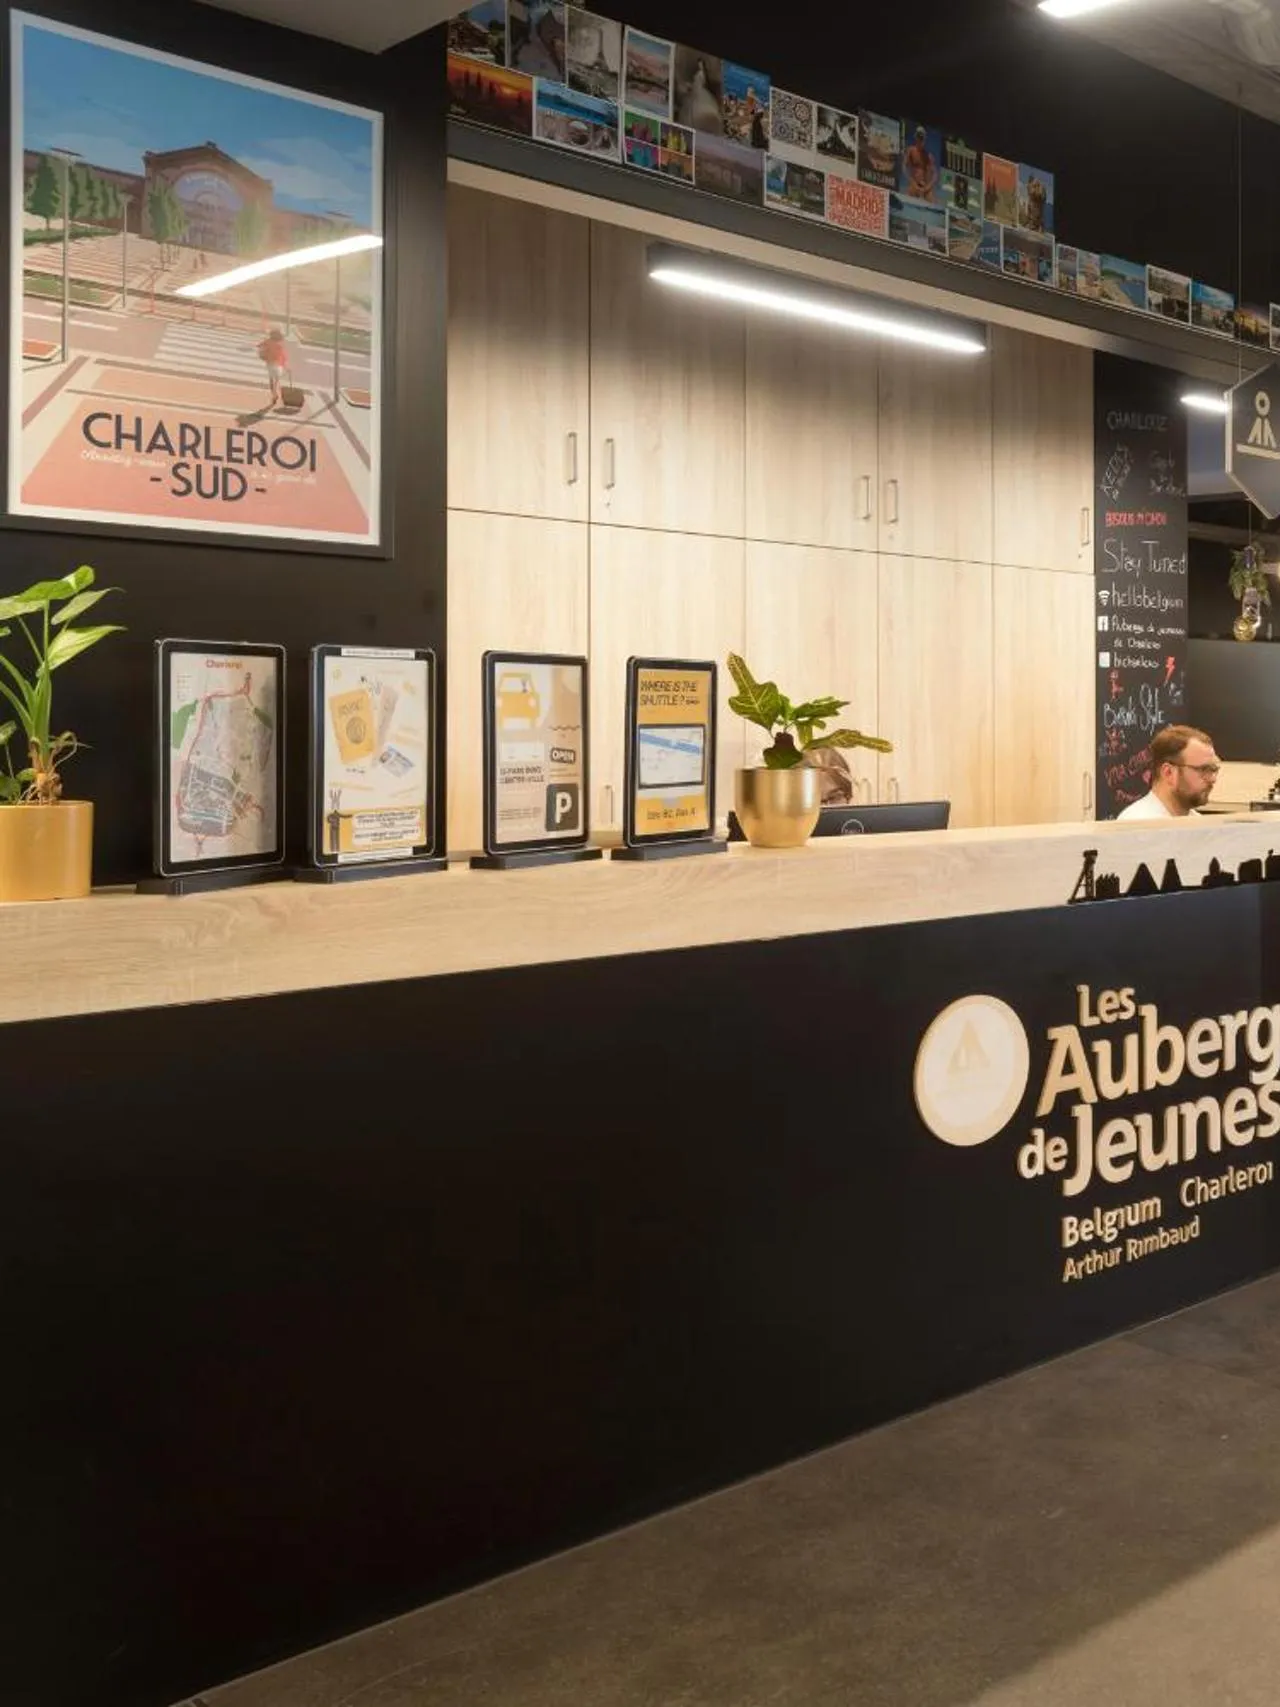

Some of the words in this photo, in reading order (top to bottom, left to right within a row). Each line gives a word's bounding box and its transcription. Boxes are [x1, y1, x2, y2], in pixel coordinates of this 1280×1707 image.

[82, 412, 317, 472] CHARLEROI
[1101, 539, 1142, 578] Stay
[1141, 540, 1188, 575] Tuned
[555, 791, 572, 824] P
[1076, 984, 1136, 1027] Les
[1018, 1128, 1069, 1179] de
[1062, 1196, 1161, 1249] Belgium
[1180, 1160, 1275, 1208] Charleroi
[1063, 1245, 1123, 1283] Arthur
[1126, 1215, 1200, 1263] Rimbaud
